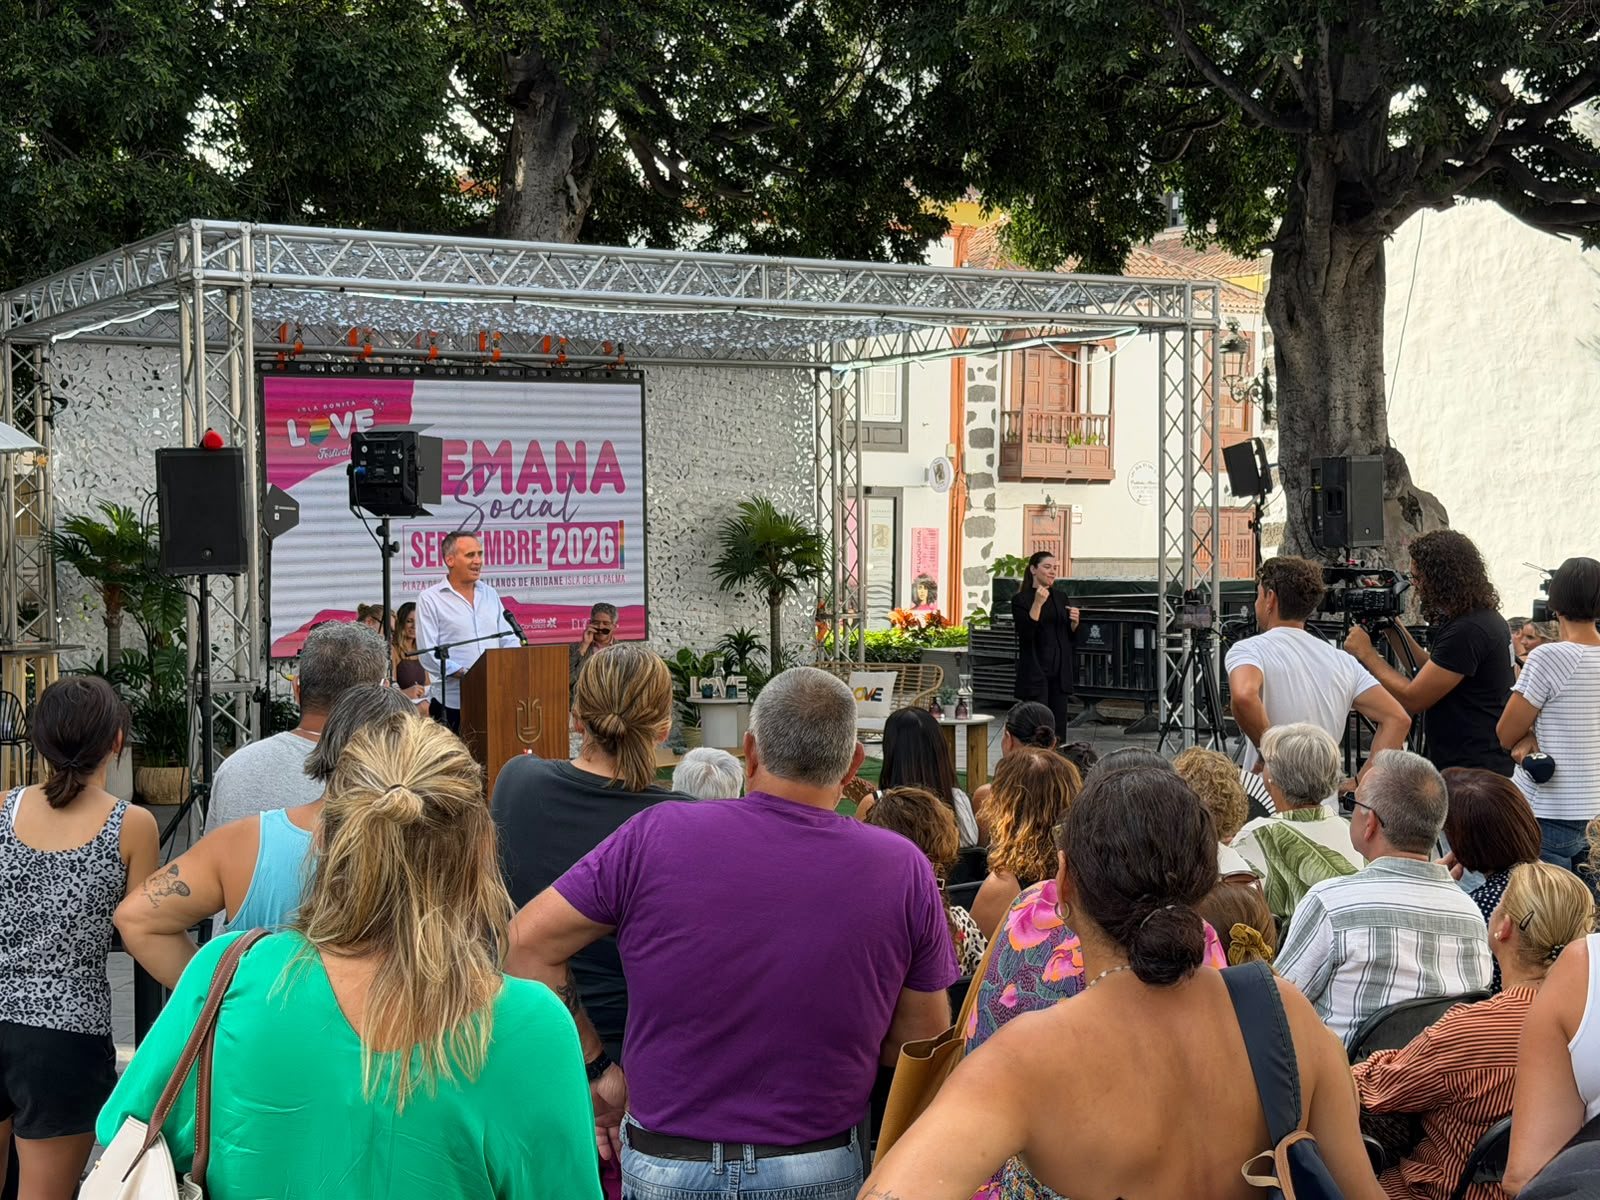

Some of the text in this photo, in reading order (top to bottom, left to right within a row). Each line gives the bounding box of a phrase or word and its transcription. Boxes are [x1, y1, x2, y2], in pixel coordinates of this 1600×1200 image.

[323, 401, 356, 410] BONITA
[287, 408, 374, 447] LOVE
[317, 443, 351, 460] Festival
[441, 439, 626, 495] EMANA
[454, 463, 580, 532] Social
[410, 526, 615, 568] SEPMBRE 2026
[402, 580, 426, 591] PLAZA
[518, 577, 529, 587] DE
[530, 576, 564, 586] ARIDANE
[565, 576, 581, 585] ISLA
[582, 576, 591, 585] DE
[593, 576, 602, 584] LA
[603, 574, 626, 584] PALMA
[853, 687, 883, 702] OVE
